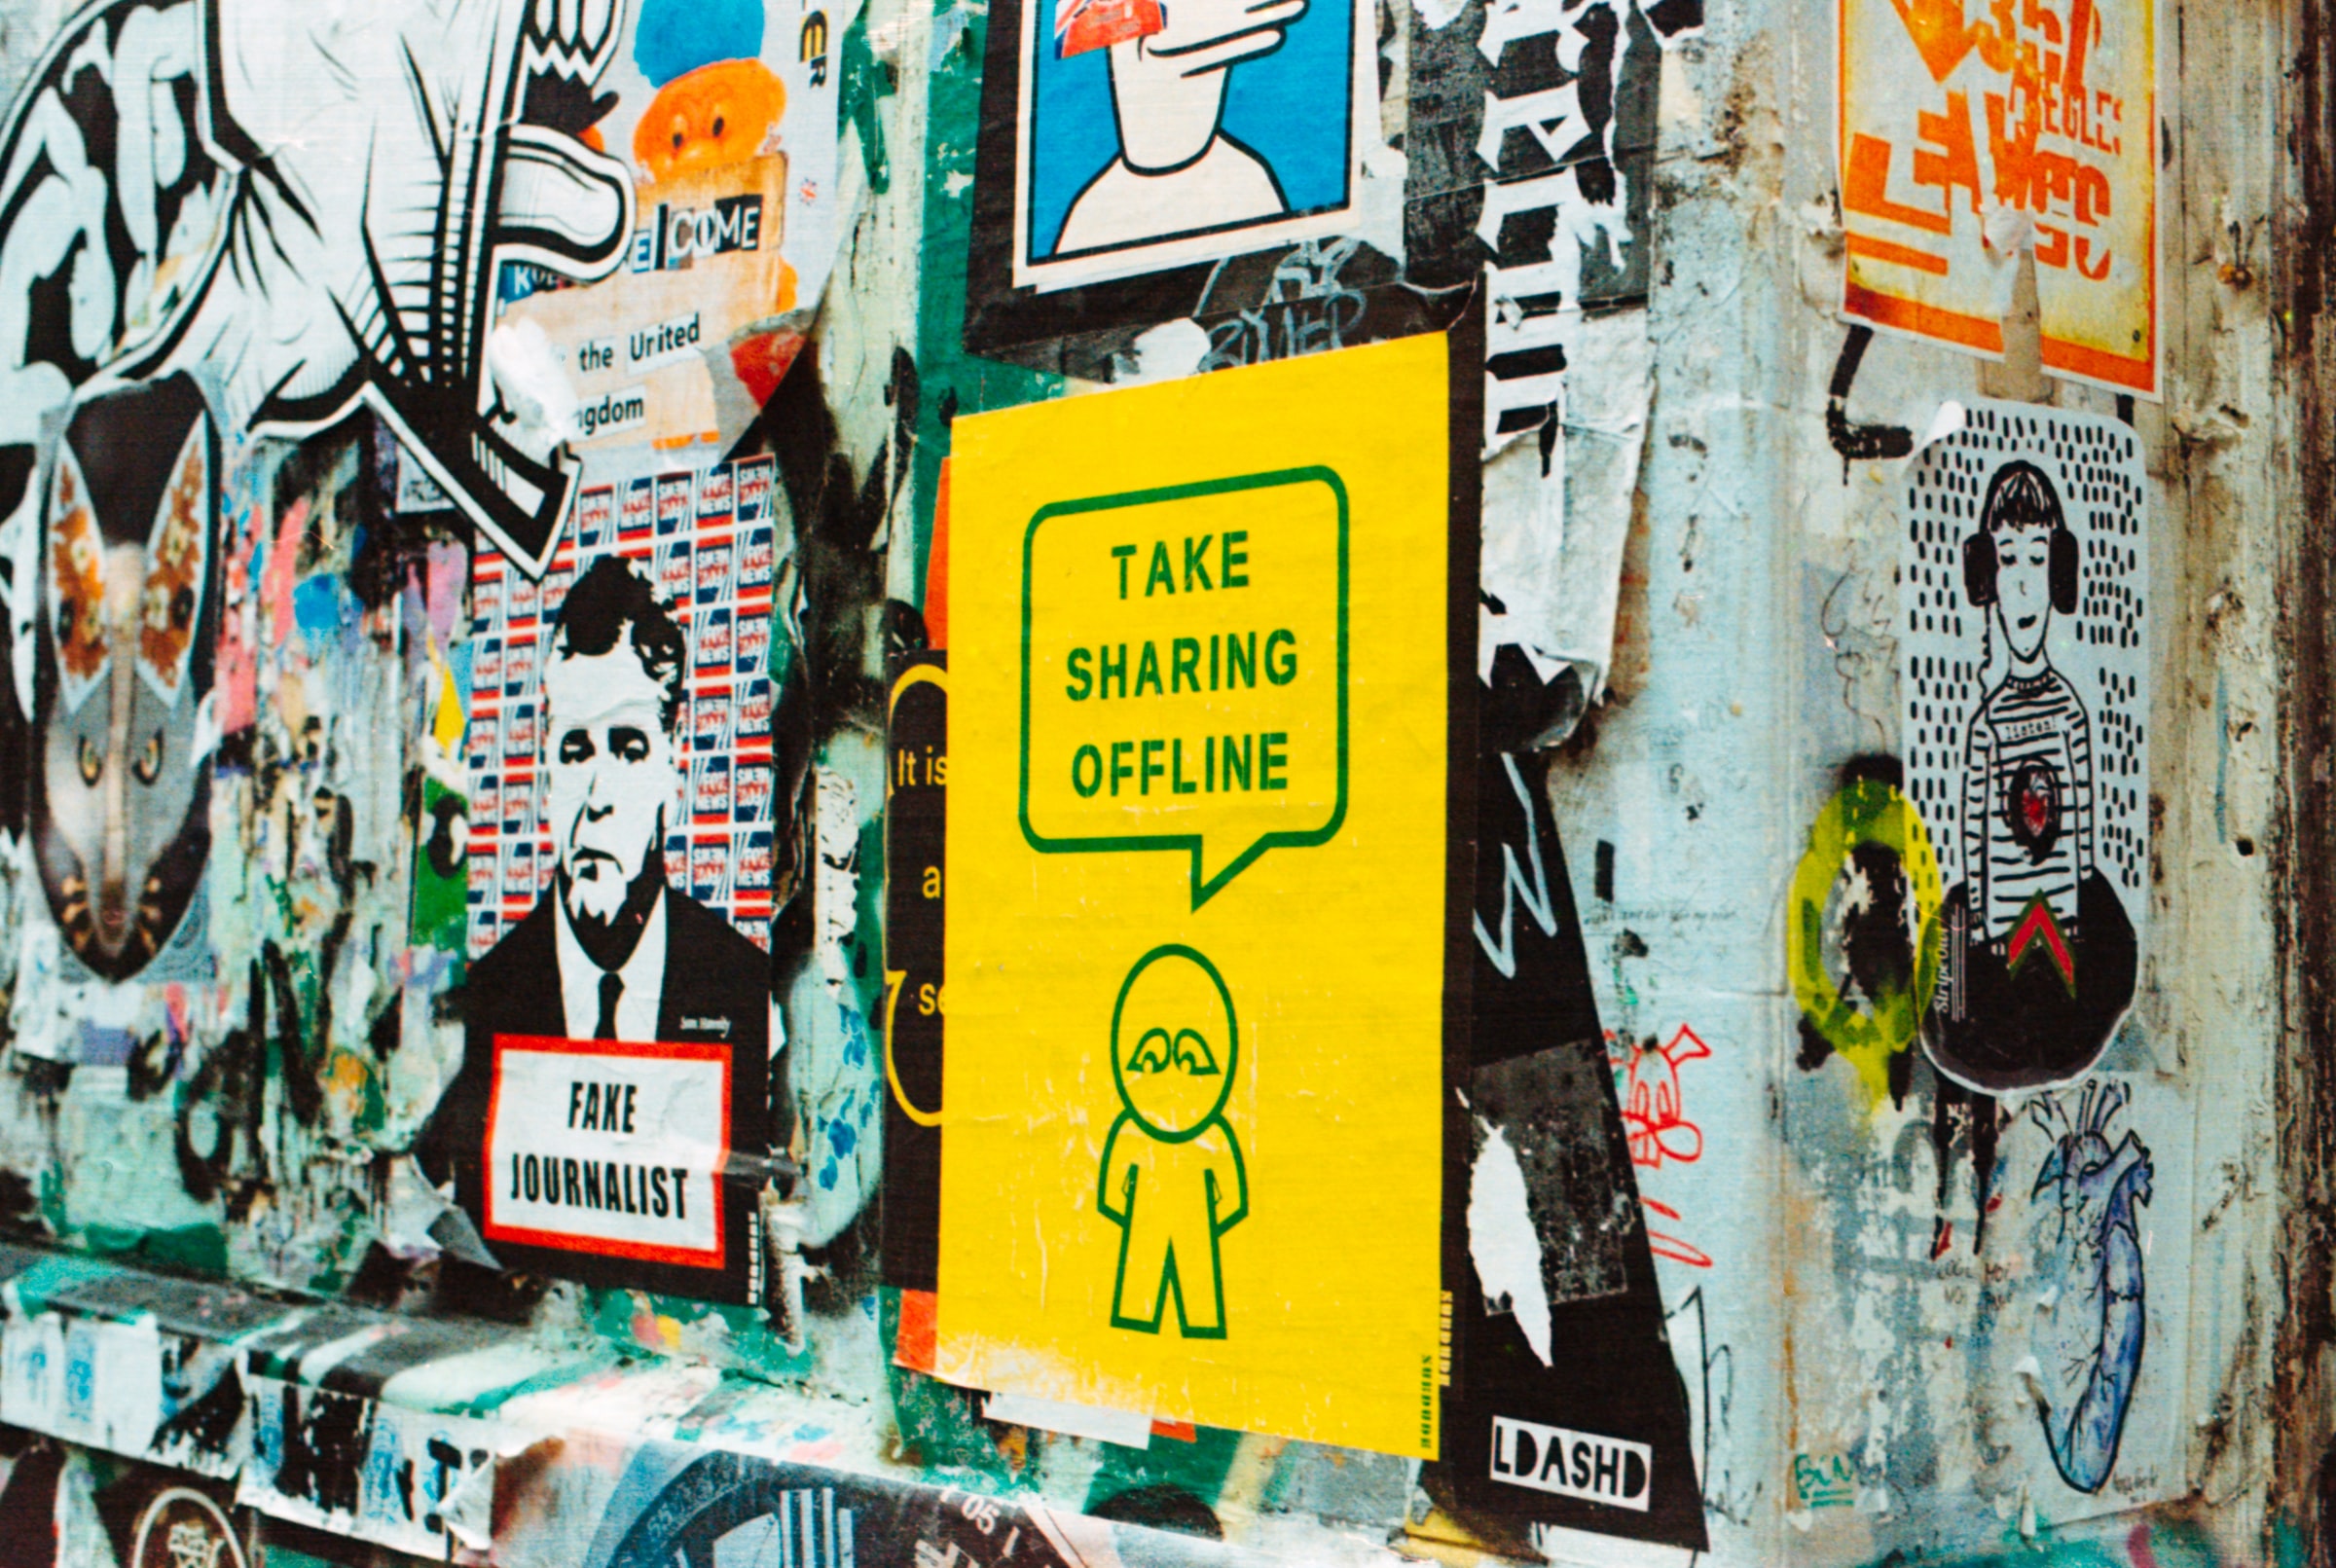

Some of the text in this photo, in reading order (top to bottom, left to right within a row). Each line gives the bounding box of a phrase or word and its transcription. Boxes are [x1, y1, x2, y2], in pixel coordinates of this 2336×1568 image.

[579, 341, 613, 371] the
[1111, 529, 1250, 601] TAKE
[1065, 628, 1298, 702] SHARING
[897, 745, 947, 787] It is
[1071, 731, 1289, 799] OFFLINE
[567, 1080, 639, 1134] FAKE
[510, 1152, 689, 1220] JOURNALIST
[1493, 1424, 1647, 1500] LDASHD
